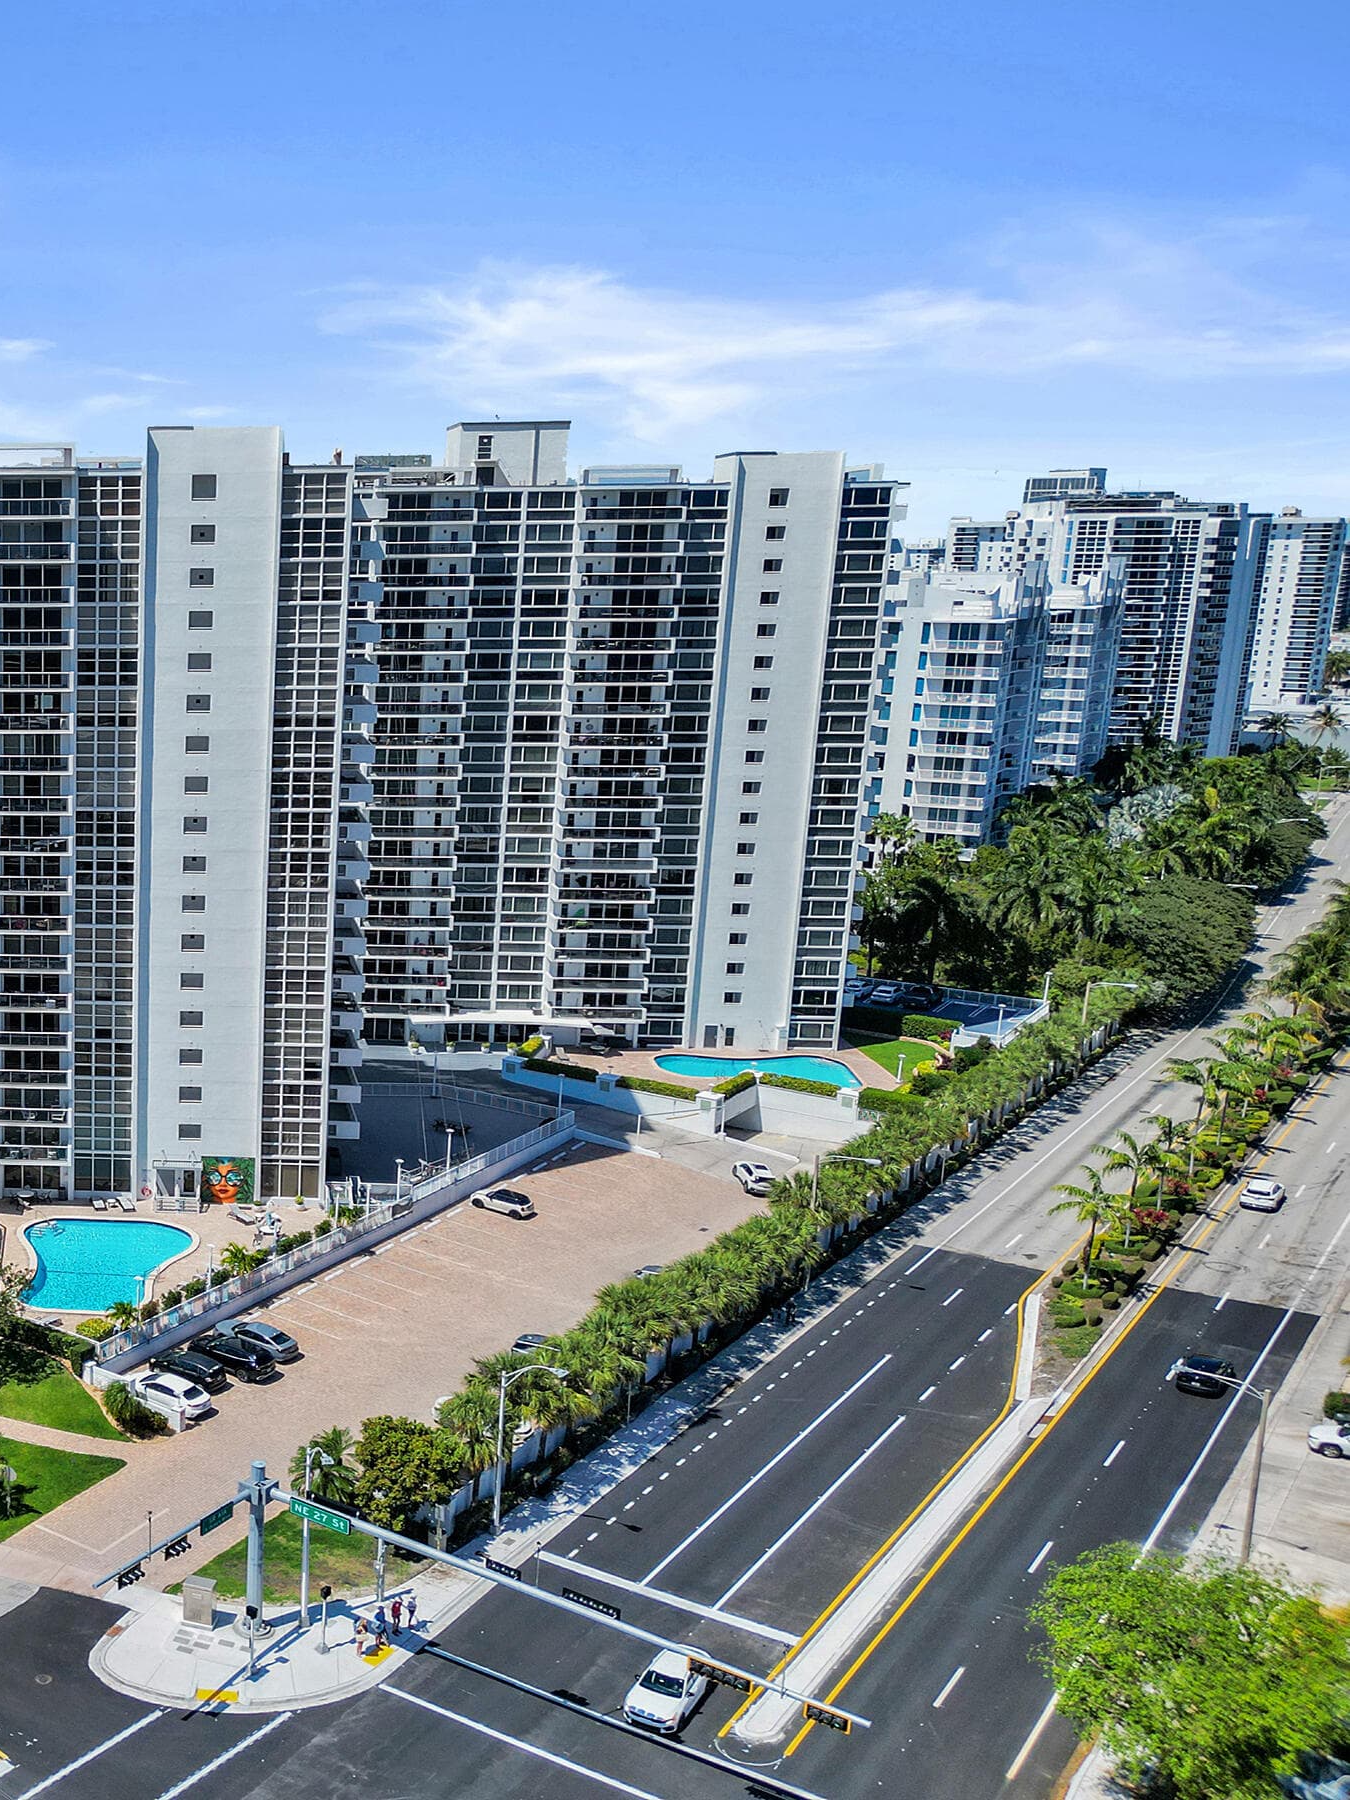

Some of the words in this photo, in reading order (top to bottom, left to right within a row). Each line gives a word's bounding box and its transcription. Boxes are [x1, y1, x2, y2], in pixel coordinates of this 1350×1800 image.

[294, 1503, 310, 1516] NE
[313, 1511, 328, 1522] 27
[332, 1518, 345, 1530] St
